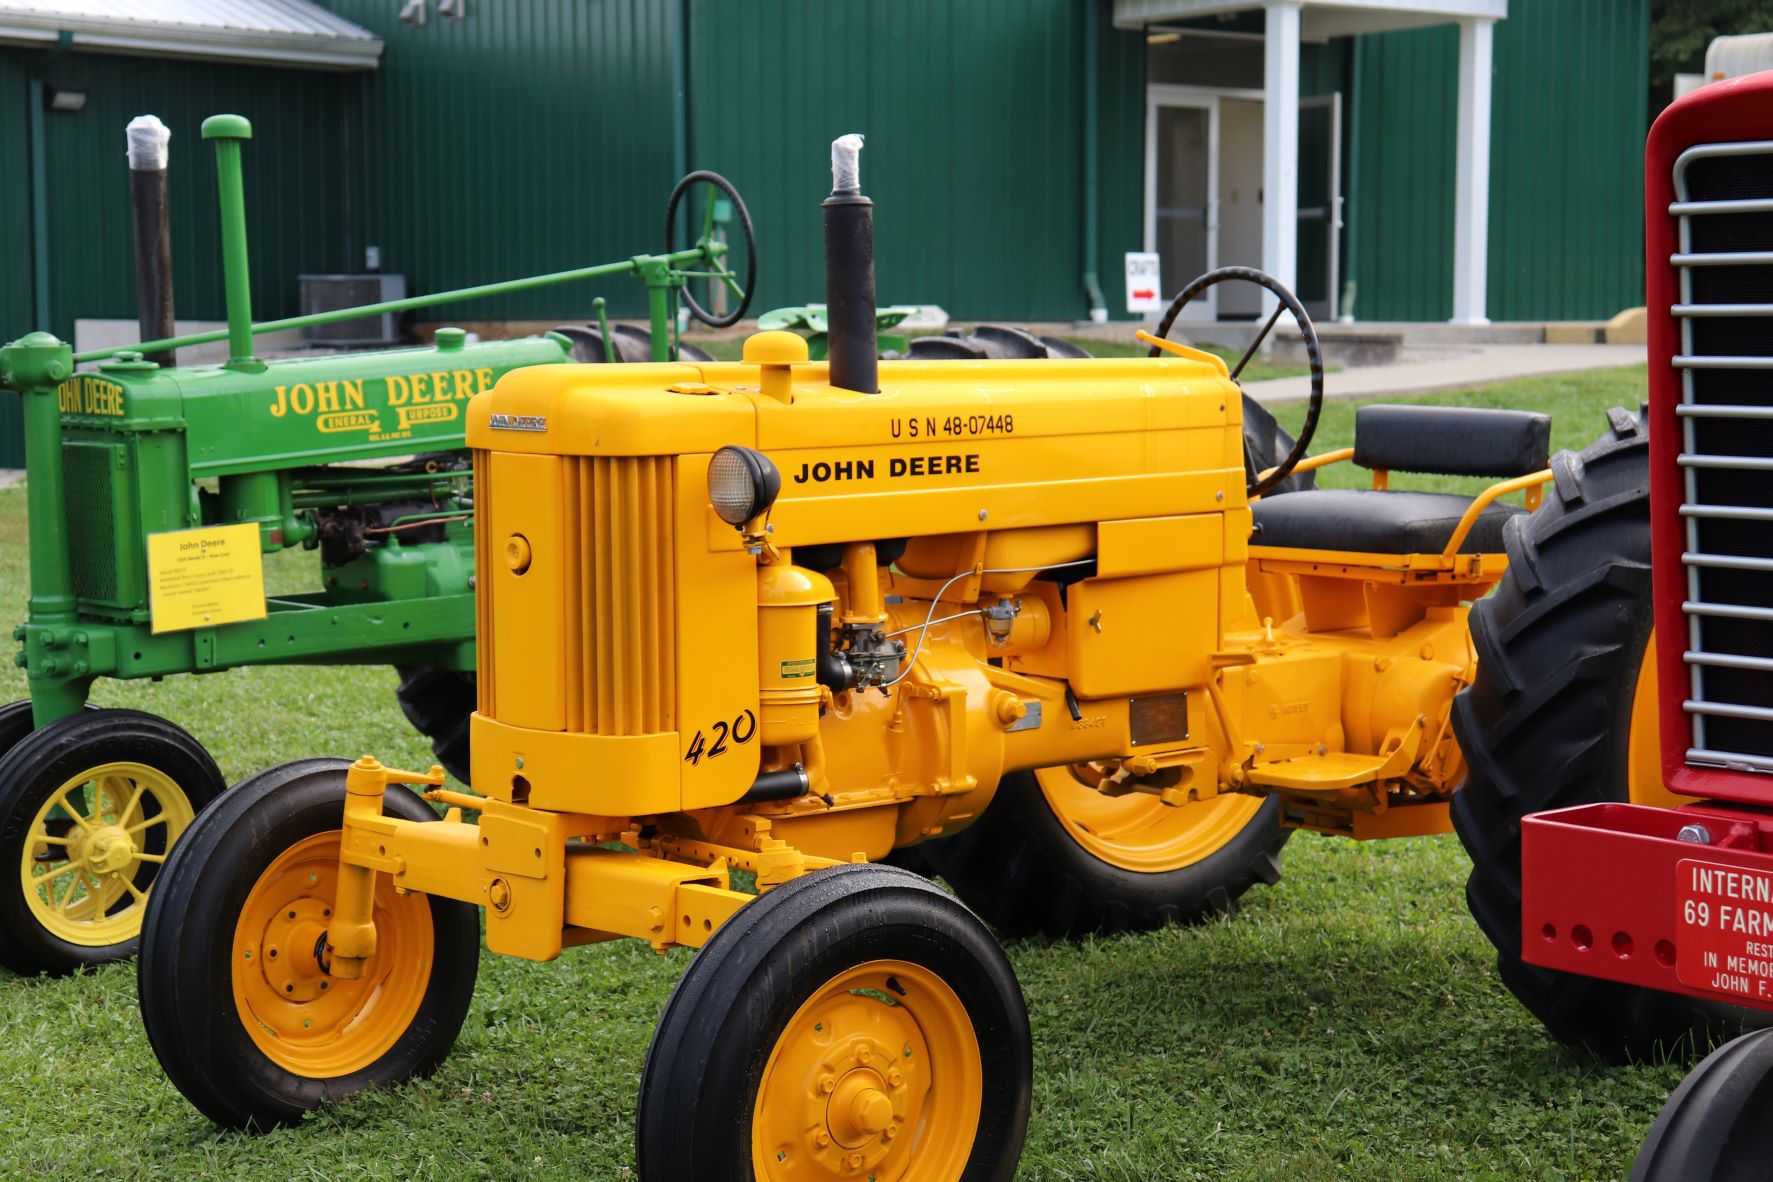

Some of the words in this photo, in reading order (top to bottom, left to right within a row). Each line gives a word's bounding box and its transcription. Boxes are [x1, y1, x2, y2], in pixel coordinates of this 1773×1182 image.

[58, 378, 82, 413] OHN
[84, 377, 124, 416] DEERE
[270, 378, 365, 418] JOHN
[385, 367, 494, 406] DEERE
[943, 414, 1014, 436] 48-07448
[793, 459, 875, 484] JOHN
[889, 454, 980, 478] DEERE
[179, 542, 199, 551] John
[200, 539, 225, 548] Deere
[684, 708, 757, 766] 420
[1692, 866, 1773, 904] INTERN
[1684, 899, 1710, 927] 69
[1704, 951, 1718, 968] IN
[1711, 971, 1749, 994] JOHN
[1758, 979, 1772, 998] F.
